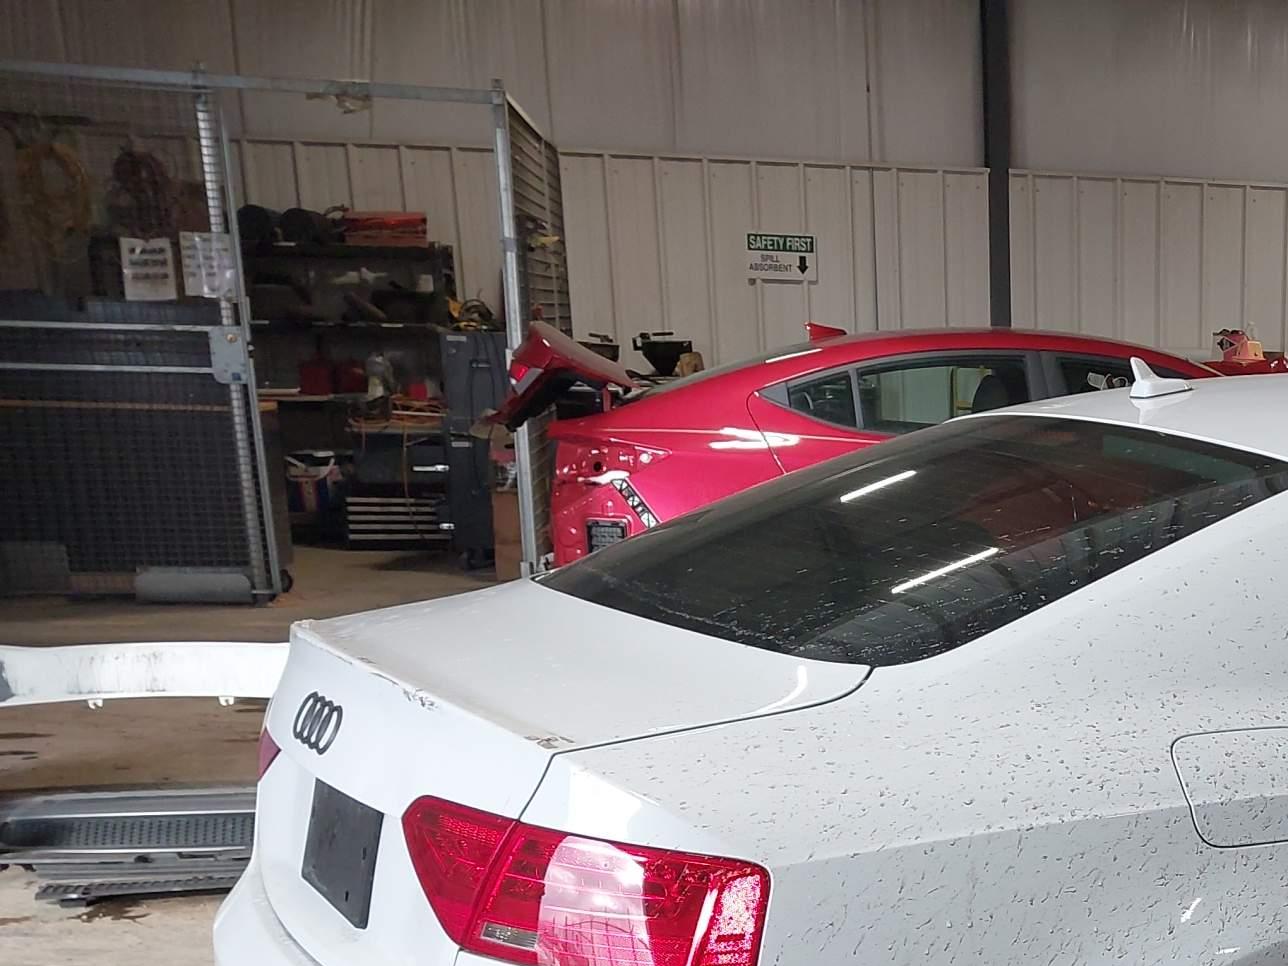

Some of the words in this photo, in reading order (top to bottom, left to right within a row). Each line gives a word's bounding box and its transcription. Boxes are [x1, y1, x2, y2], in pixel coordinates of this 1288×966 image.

[749, 236, 784, 250] SAFETY
[786, 237, 812, 251] FIRST
[760, 254, 780, 263] SPILL
[749, 263, 793, 273] ABSORBENT
